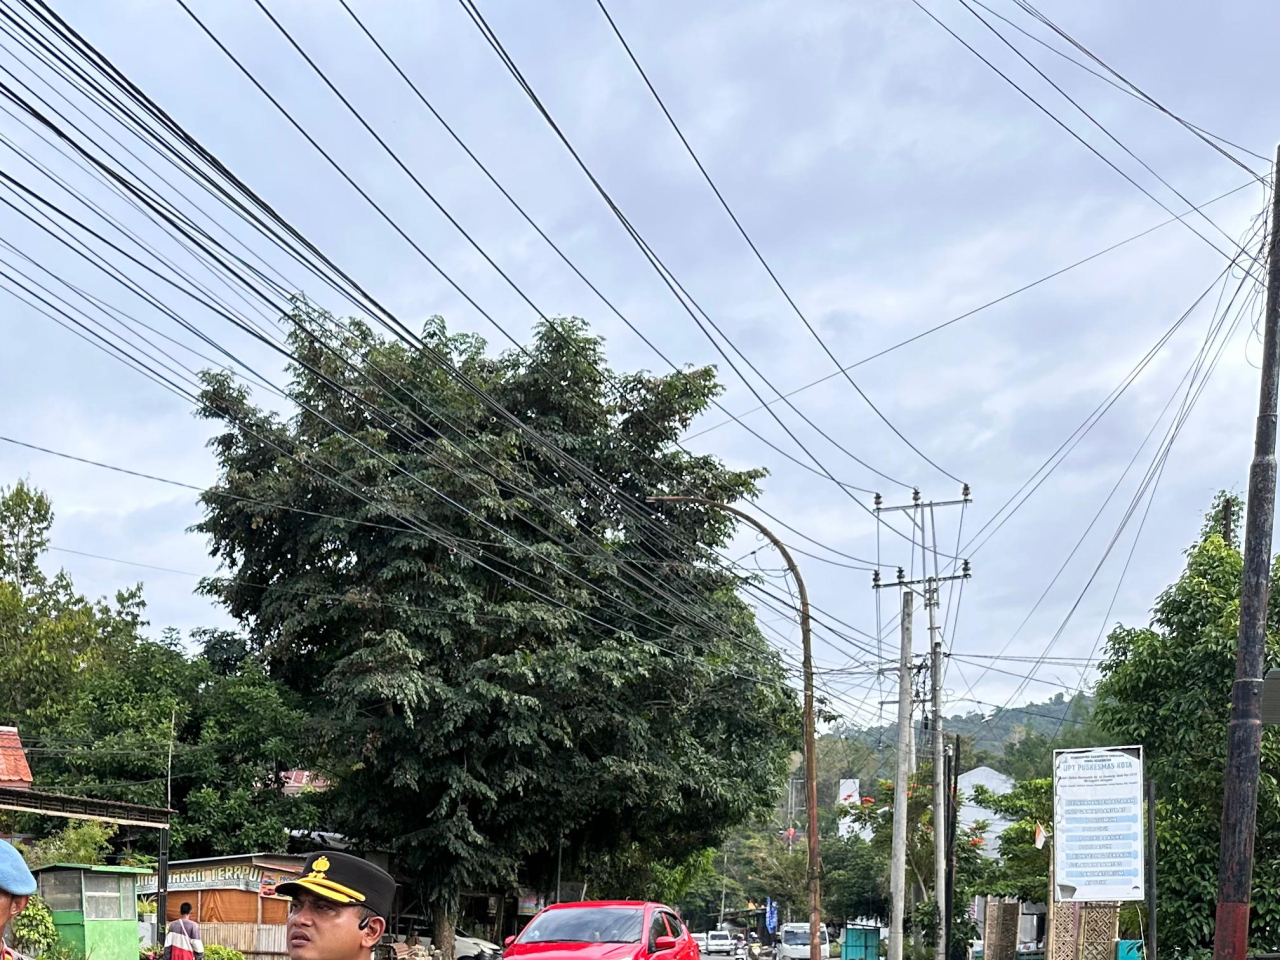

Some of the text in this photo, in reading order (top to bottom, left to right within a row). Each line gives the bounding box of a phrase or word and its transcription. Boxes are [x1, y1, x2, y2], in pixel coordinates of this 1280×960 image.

[1063, 761, 1133, 772] UPT PUSKESMAS KOTA
